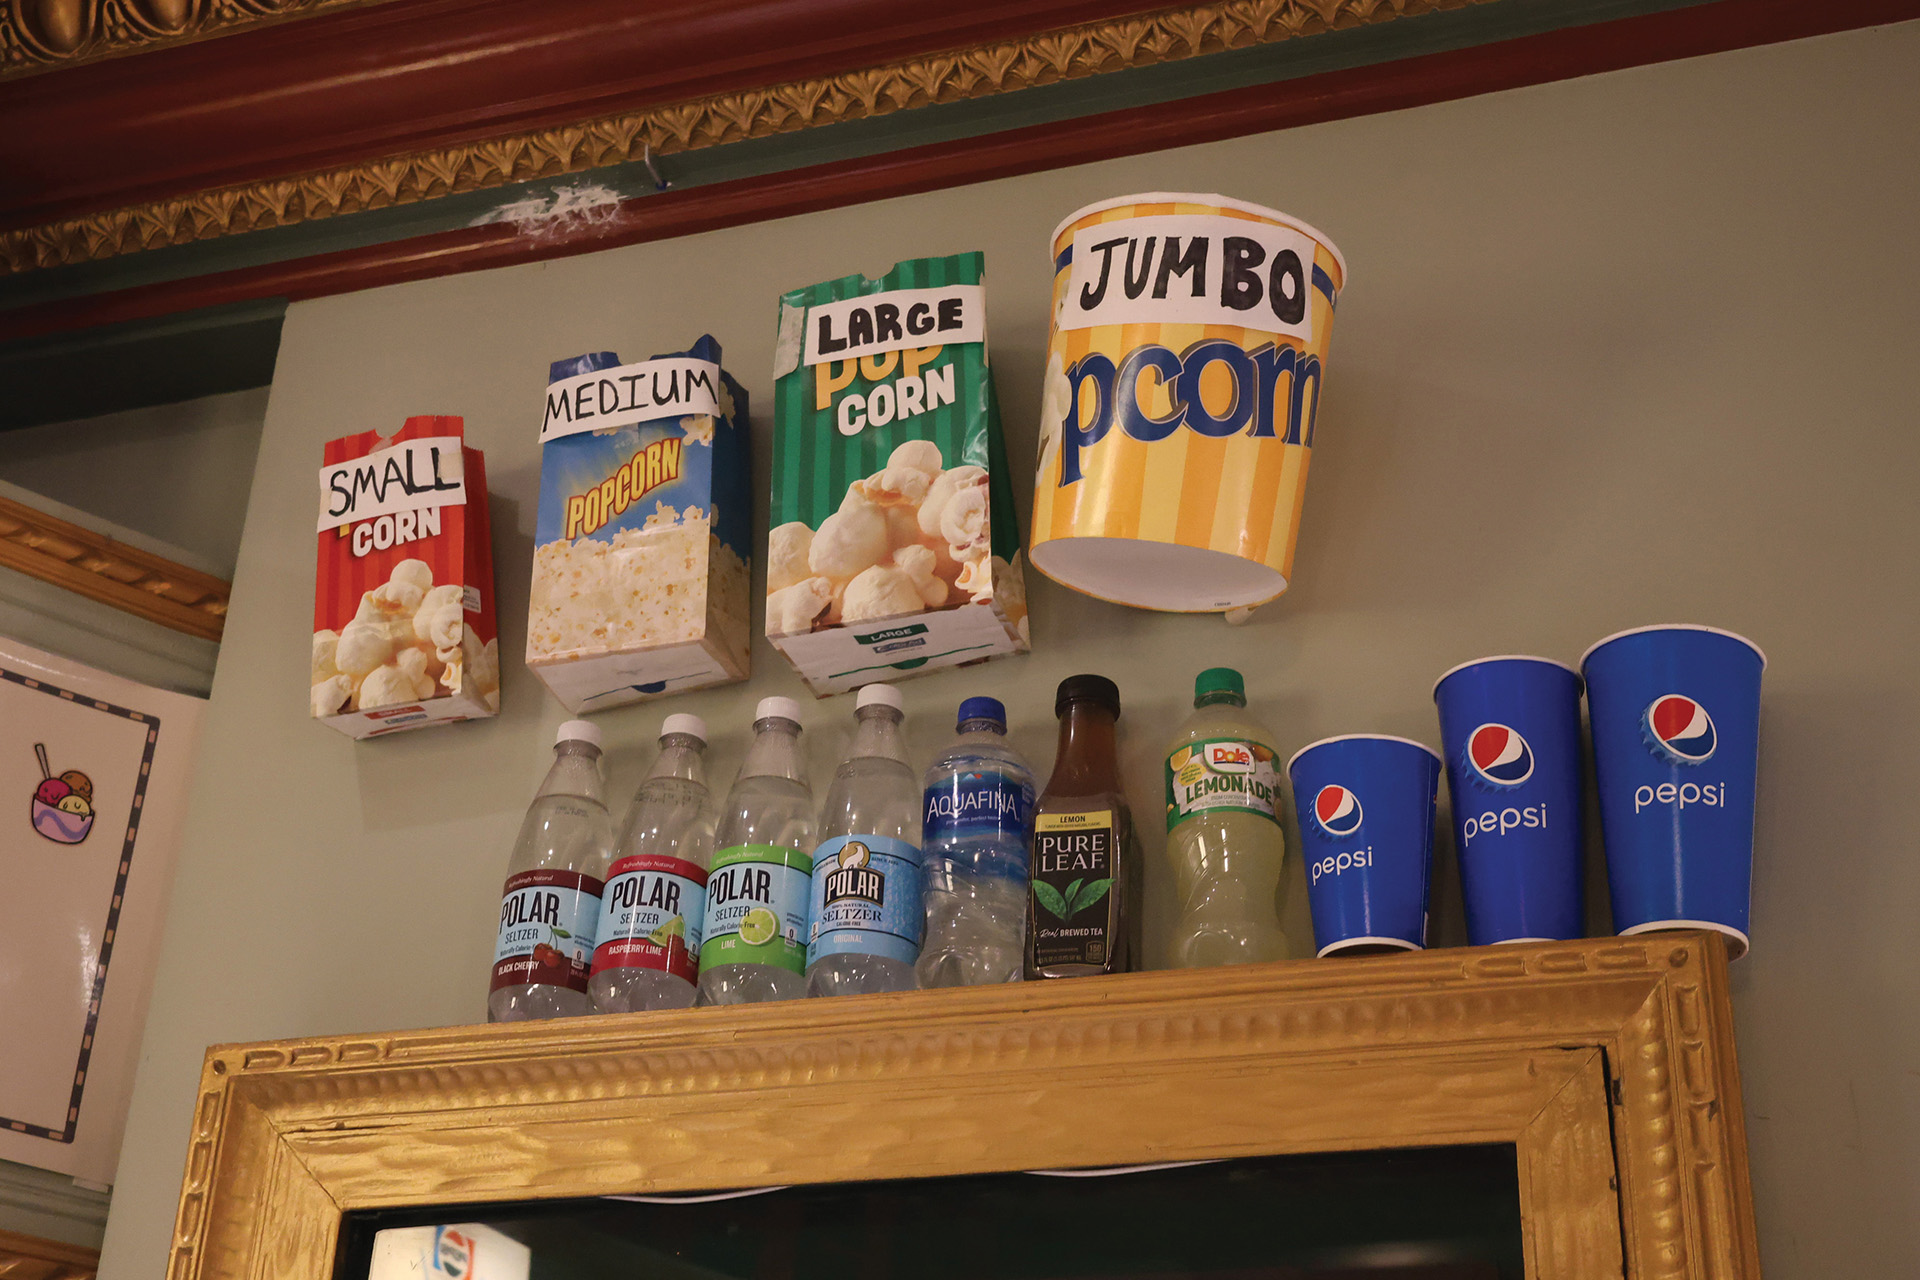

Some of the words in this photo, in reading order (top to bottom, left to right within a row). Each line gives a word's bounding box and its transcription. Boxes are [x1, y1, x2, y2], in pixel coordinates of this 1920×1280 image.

[1079, 236, 1306, 325] JUMBO
[818, 298, 963, 355] LARGE
[543, 369, 718, 433] MEDIUM
[838, 363, 956, 436] CORN
[329, 447, 461, 517] SMALL
[566, 437, 682, 540] POPCORN
[353, 506, 441, 557] CORN
[870, 627, 913, 642] LARGE
[1213, 748, 1250, 763] Dole
[1186, 775, 1274, 806] LEMONADE
[1635, 782, 1726, 813] pepsi
[927, 791, 1019, 823] AQUAFINA
[1060, 815, 1086, 823] LEMON
[1464, 803, 1548, 847] pepsi
[1042, 834, 1104, 854] PURE
[1042, 852, 1104, 872] LEAF
[1312, 846, 1373, 886] pepsi
[610, 875, 681, 915] POLAR
[708, 868, 771, 912] POLAR
[826, 870, 879, 902] POLAR
[499, 891, 560, 935] POLAR
[715, 905, 751, 922] SELTZER
[822, 908, 882, 925] SELTZER
[505, 928, 539, 944] SELTZER
[721, 939, 736, 950] LIME
[1060, 928, 1090, 937] BREWED
[1090, 927, 1103, 936] TEA
[608, 944, 646, 955] RASPBERRY
[645, 945, 663, 956] LIME
[498, 963, 513, 976] BLACK
[513, 960, 540, 971] CHERRY
